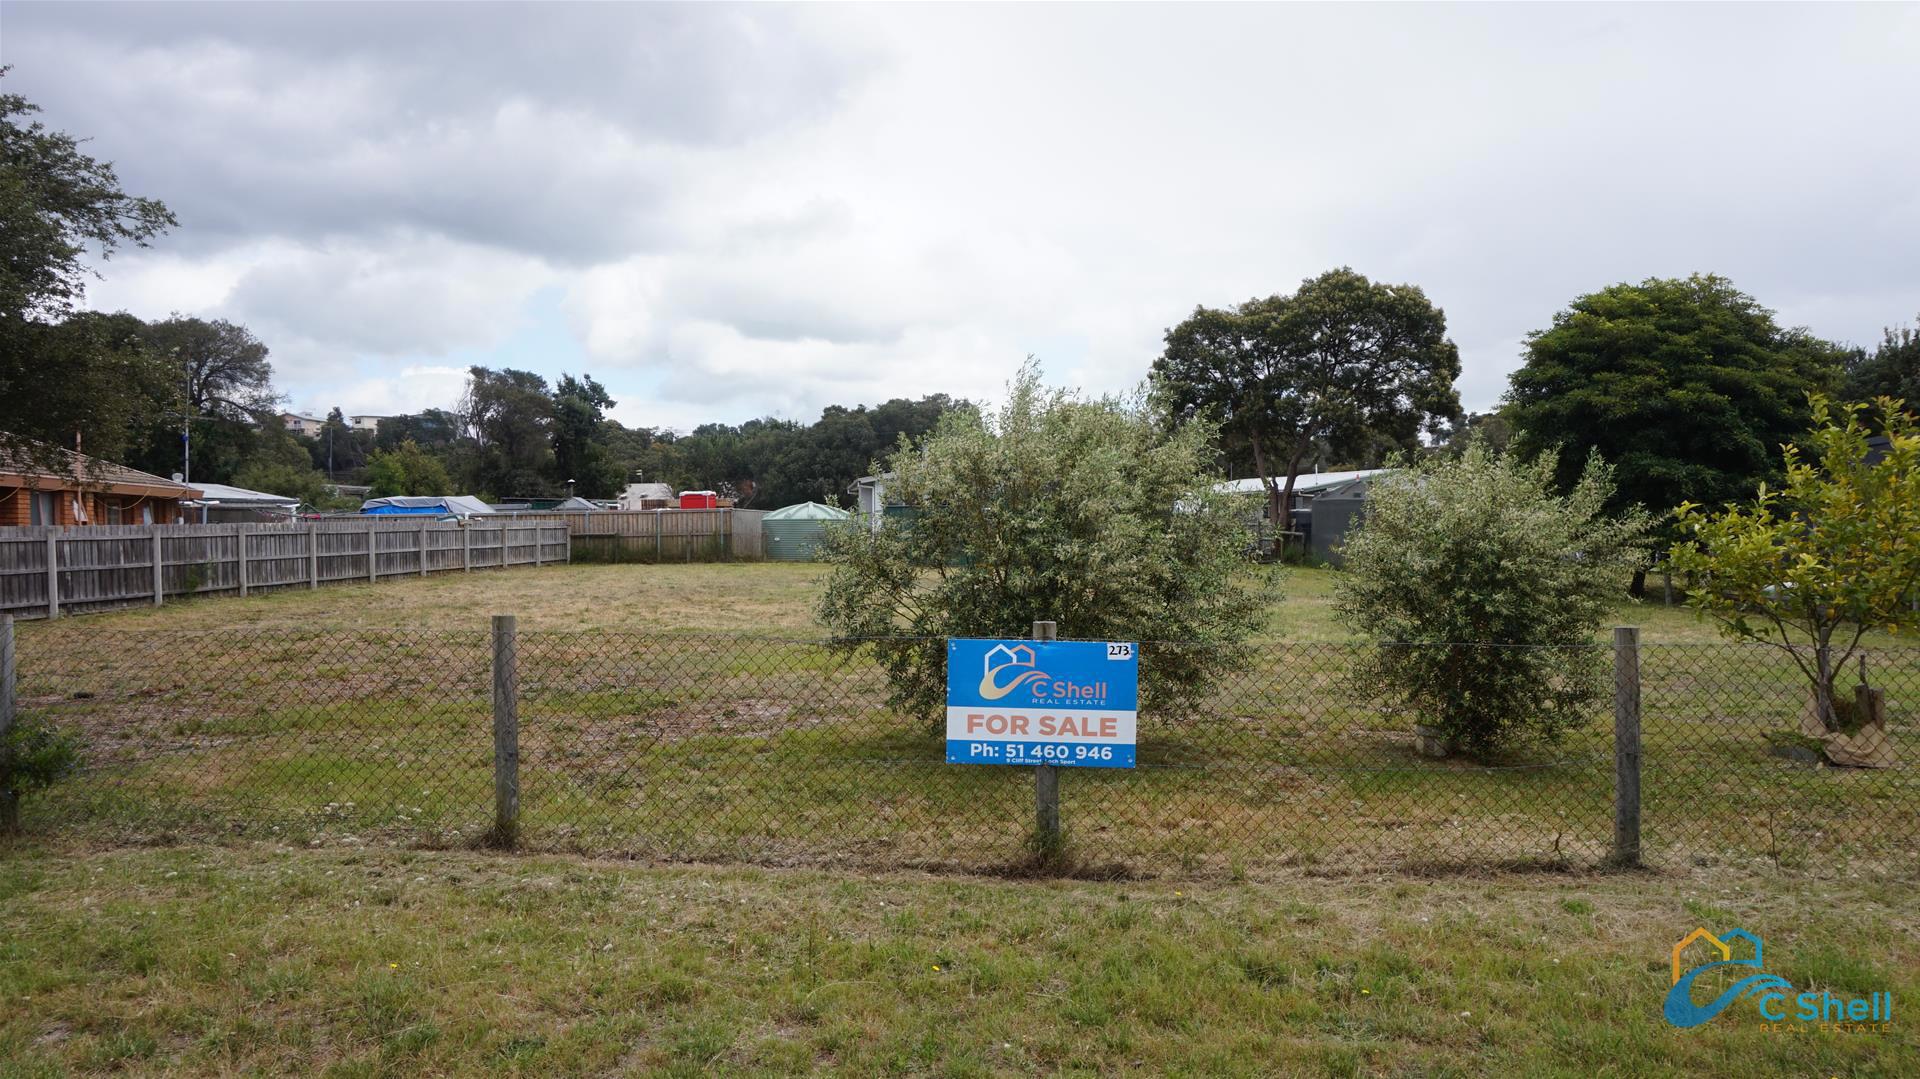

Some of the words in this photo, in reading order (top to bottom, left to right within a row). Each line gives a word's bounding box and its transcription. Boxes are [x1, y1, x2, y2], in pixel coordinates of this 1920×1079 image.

[1031, 682, 1048, 698] C
[1053, 682, 1107, 699] Shell
[967, 714, 1030, 735] FOR
[1038, 715, 1118, 737] SALE
[970, 743, 999, 757] Ph:
[1005, 744, 1025, 757] 51
[1030, 745, 1069, 759] 460
[1075, 746, 1113, 760] 946
